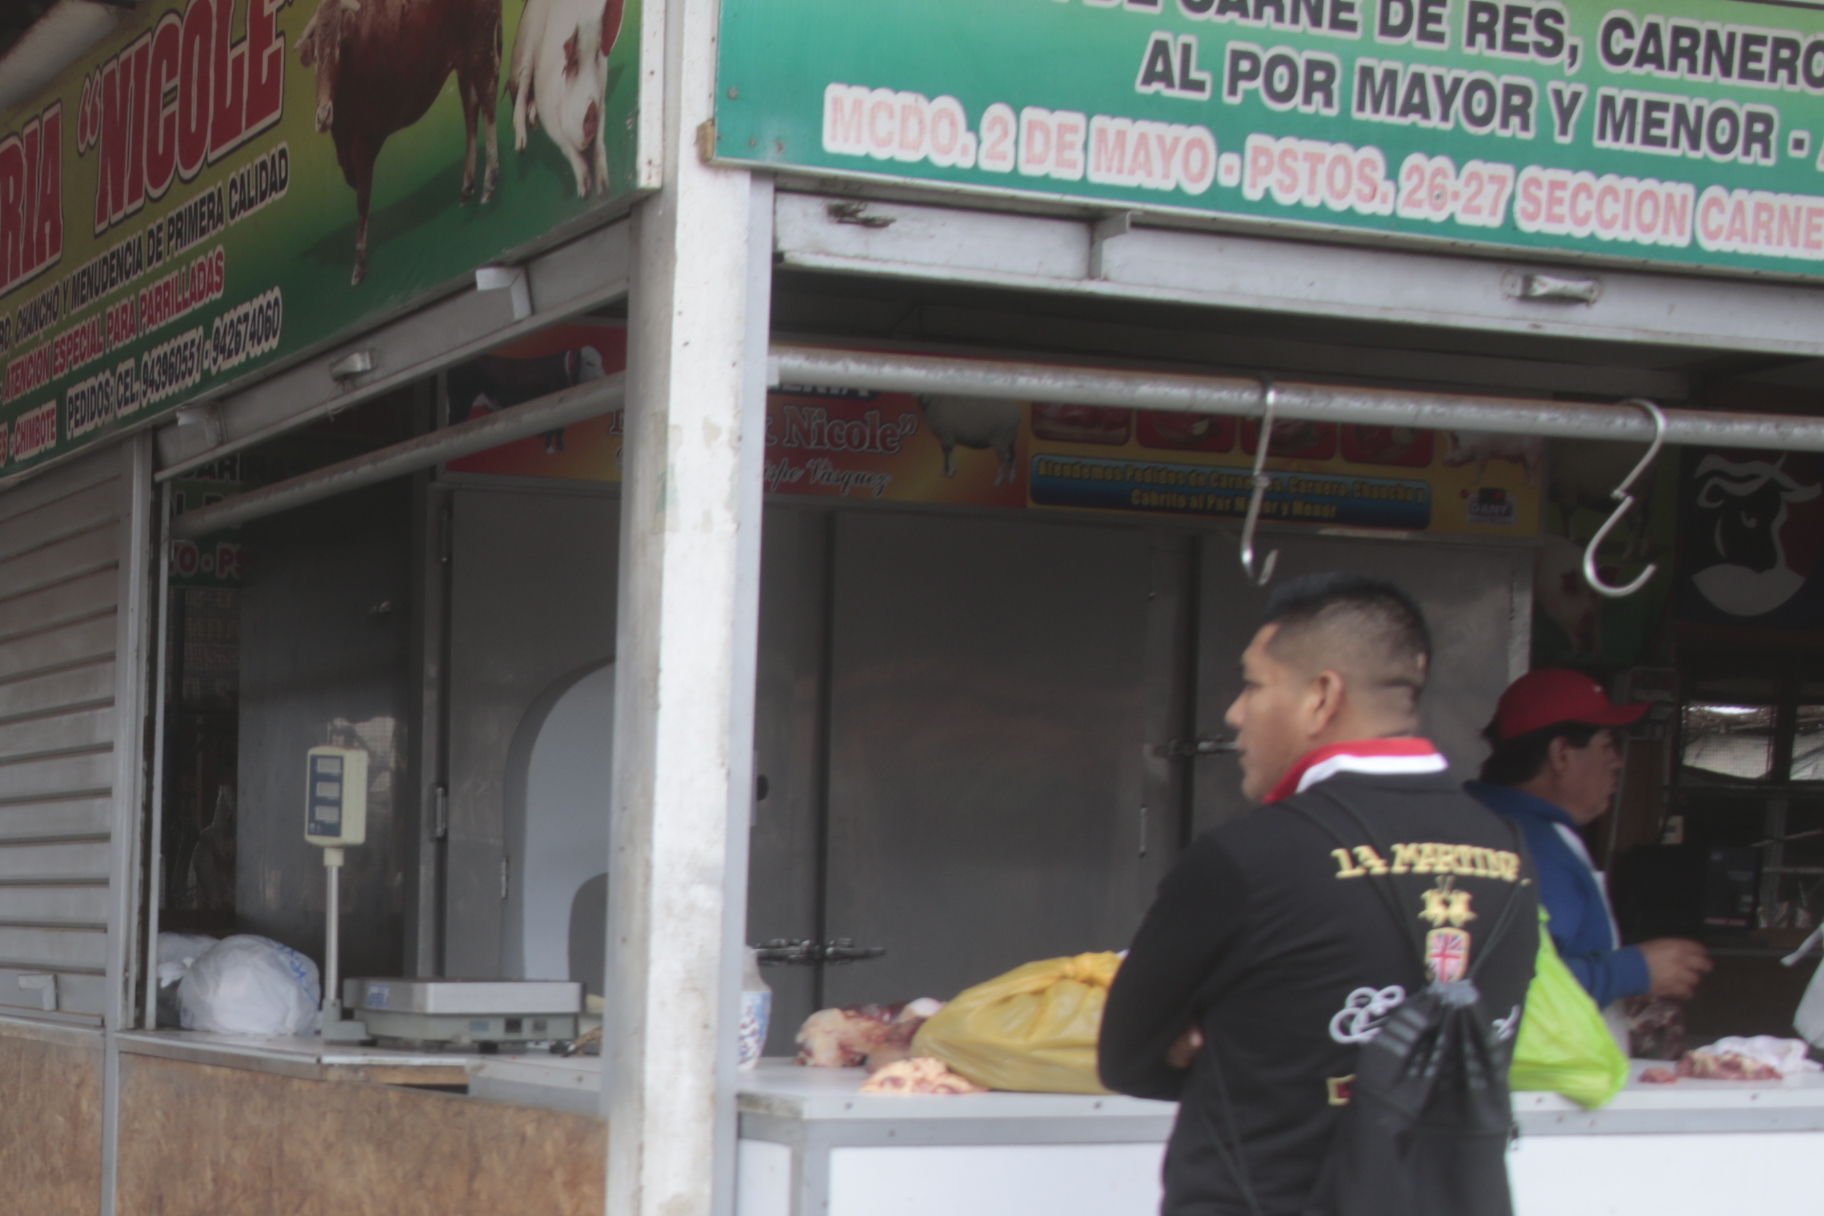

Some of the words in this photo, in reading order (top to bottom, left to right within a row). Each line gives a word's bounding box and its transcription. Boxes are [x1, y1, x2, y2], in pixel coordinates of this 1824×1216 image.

[1378, 0, 1447, 44] DE
[1466, 0, 1578, 69] RES,
[1139, 38, 1207, 93] AL
[1227, 47, 1337, 109] POR
[1355, 64, 1534, 133] MAYOR
[1551, 87, 1583, 138] Y
[1596, 92, 1775, 160] MENOR
[828, 94, 970, 159] MCDO.
[984, 114, 1010, 163] 2
[1024, 118, 1080, 170] DE
[1092, 125, 1211, 185] MAYO
[1247, 144, 1390, 205] PSTOS.
[1402, 162, 1510, 219] 26-27
[1519, 174, 1690, 238] SECCION
[15, 282, 59, 346] CHANCHO
[62, 276, 69, 316] Y
[71, 233, 144, 309] MENUDENCIA
[146, 221, 164, 270] DE
[167, 185, 225, 257] PRIMERA
[227, 148, 289, 223] CALIDAD
[52, 315, 103, 377] ESPECIAL
[106, 296, 136, 351] PARA
[140, 248, 225, 337] PARRILLADAS
[15, 406, 56, 459] CHIMBOTE
[67, 375, 114, 433] PEDIDOS:
[116, 364, 141, 411] CEL.
[141, 334, 203, 398] 943960551
[211, 295, 281, 368] 942674060
[1037, 459, 1124, 482] Atendemos
[1125, 465, 1186, 487] Pedidos
[1187, 469, 1207, 488] de
[1209, 470, 1255, 491] Carne
[1352, 481, 1414, 503] Chancho
[1131, 487, 1187, 509] Cabrito
[1189, 492, 1205, 510] al
[1206, 494, 1231, 512] Por
[1291, 499, 1339, 518] Menor
